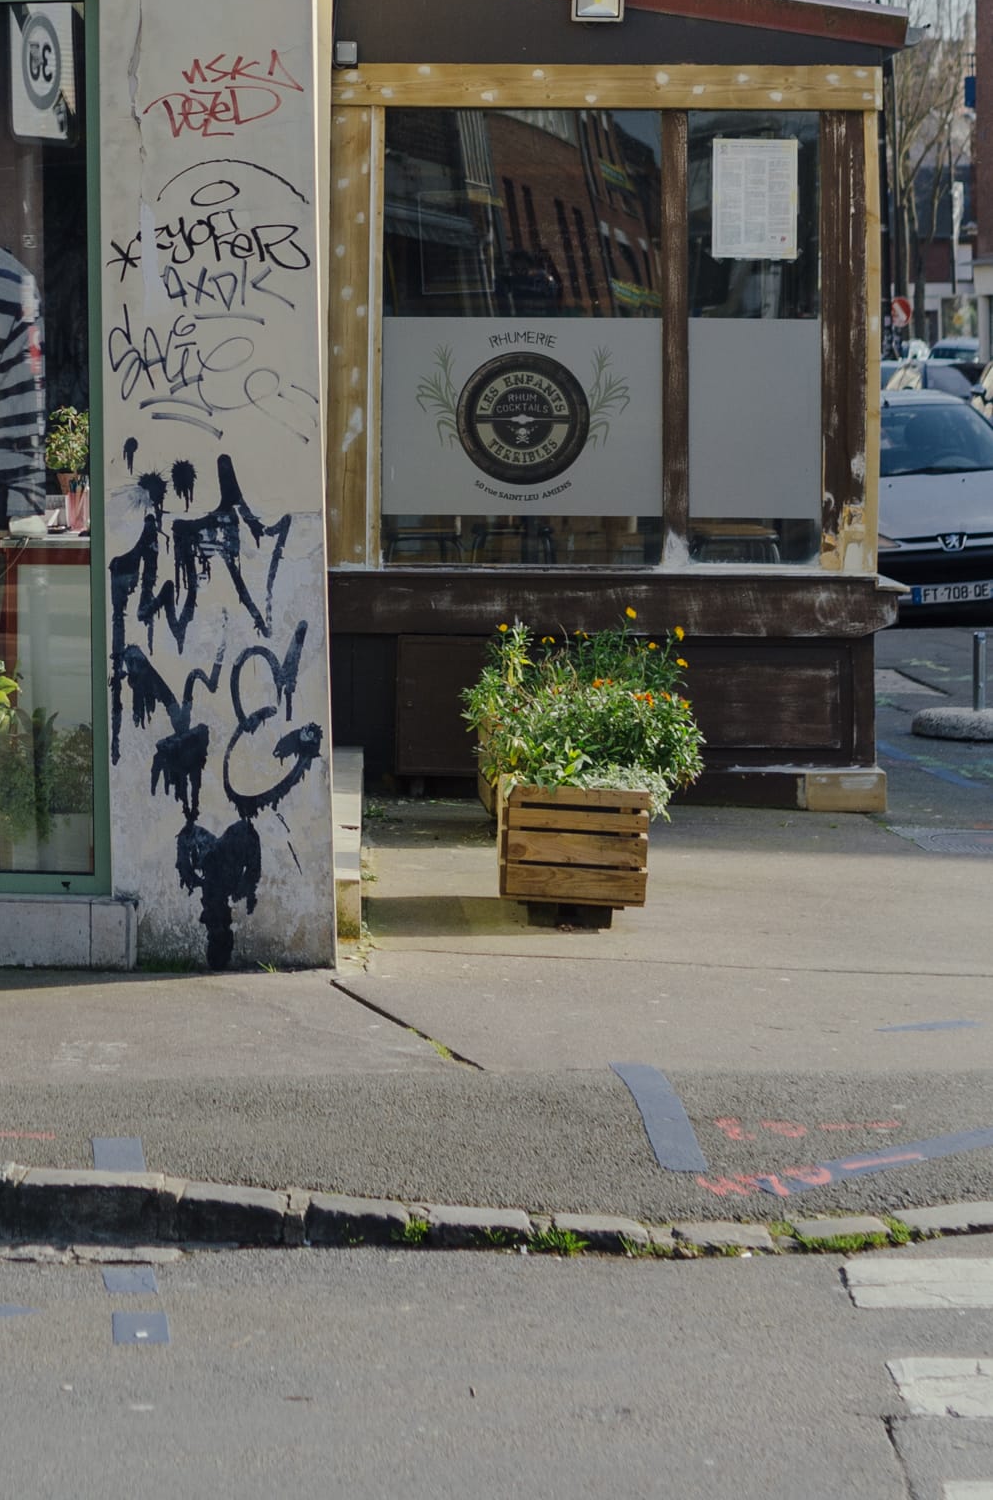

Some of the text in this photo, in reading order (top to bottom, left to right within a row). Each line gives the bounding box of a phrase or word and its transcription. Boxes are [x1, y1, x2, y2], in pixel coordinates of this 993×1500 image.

[488, 331, 557, 348] RHUMERIE
[479, 373, 566, 413] LES ENFANTS
[508, 393, 537, 402] RHUM
[496, 403, 549, 414] COCKTAILS
[488, 438, 558, 463] TERRIBLES
[484, 486, 498, 496] rue
[498, 491, 522, 501] SAINT
[524, 493, 539, 501] LEU
[542, 480, 572, 499] AMIENS
